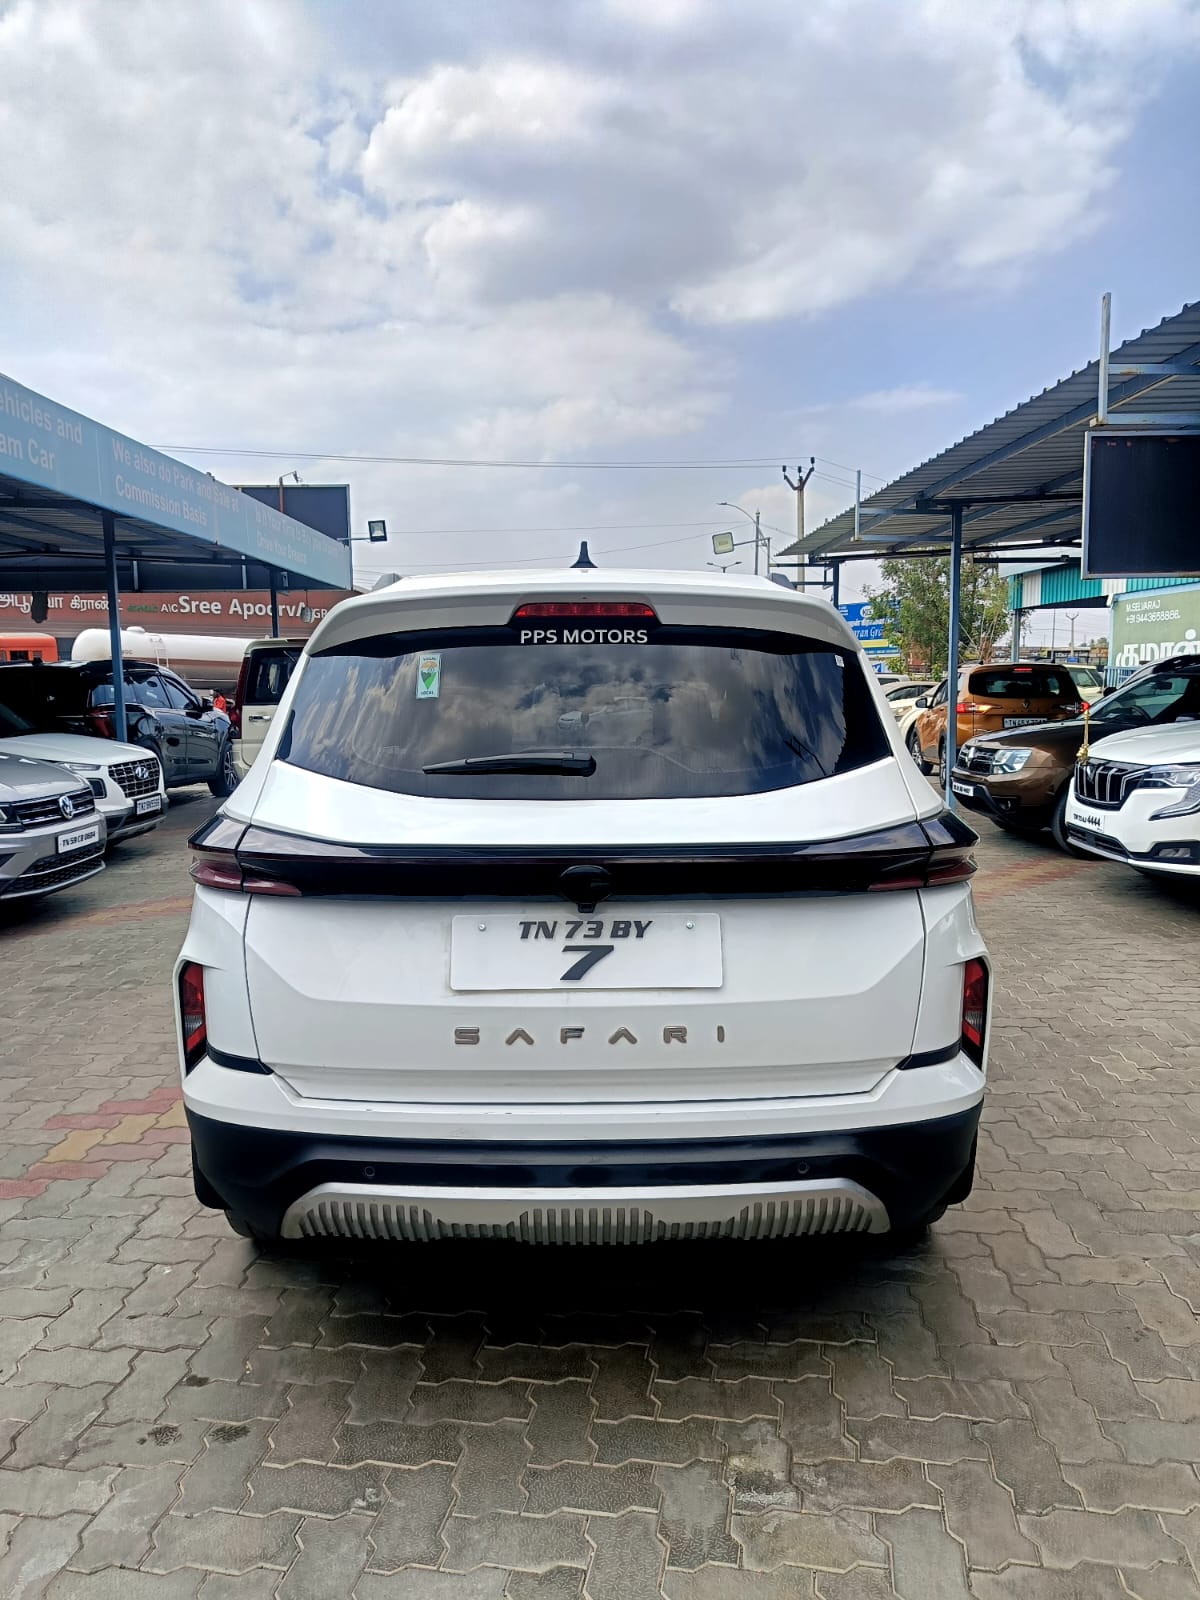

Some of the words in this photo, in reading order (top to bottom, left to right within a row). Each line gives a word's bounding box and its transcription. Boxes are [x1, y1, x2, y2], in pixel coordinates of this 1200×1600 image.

[56, 418, 82, 446] and
[28, 438, 55, 471] Car
[111, 438, 131, 465] We
[133, 450, 157, 477] also
[158, 460, 172, 483] do
[173, 465, 194, 494] Park
[196, 480, 213, 500] and
[115, 473, 180, 517] Commission
[182, 500, 208, 527] Basis
[178, 595, 222, 615] Sree
[520, 629, 558, 644] PPS
[563, 629, 648, 644] MOTORS
[518, 920, 557, 939] TN
[565, 920, 604, 939] 73
[610, 920, 653, 939] BY
[559, 944, 615, 981] 7
[454, 1024, 726, 1046] SAFARI
